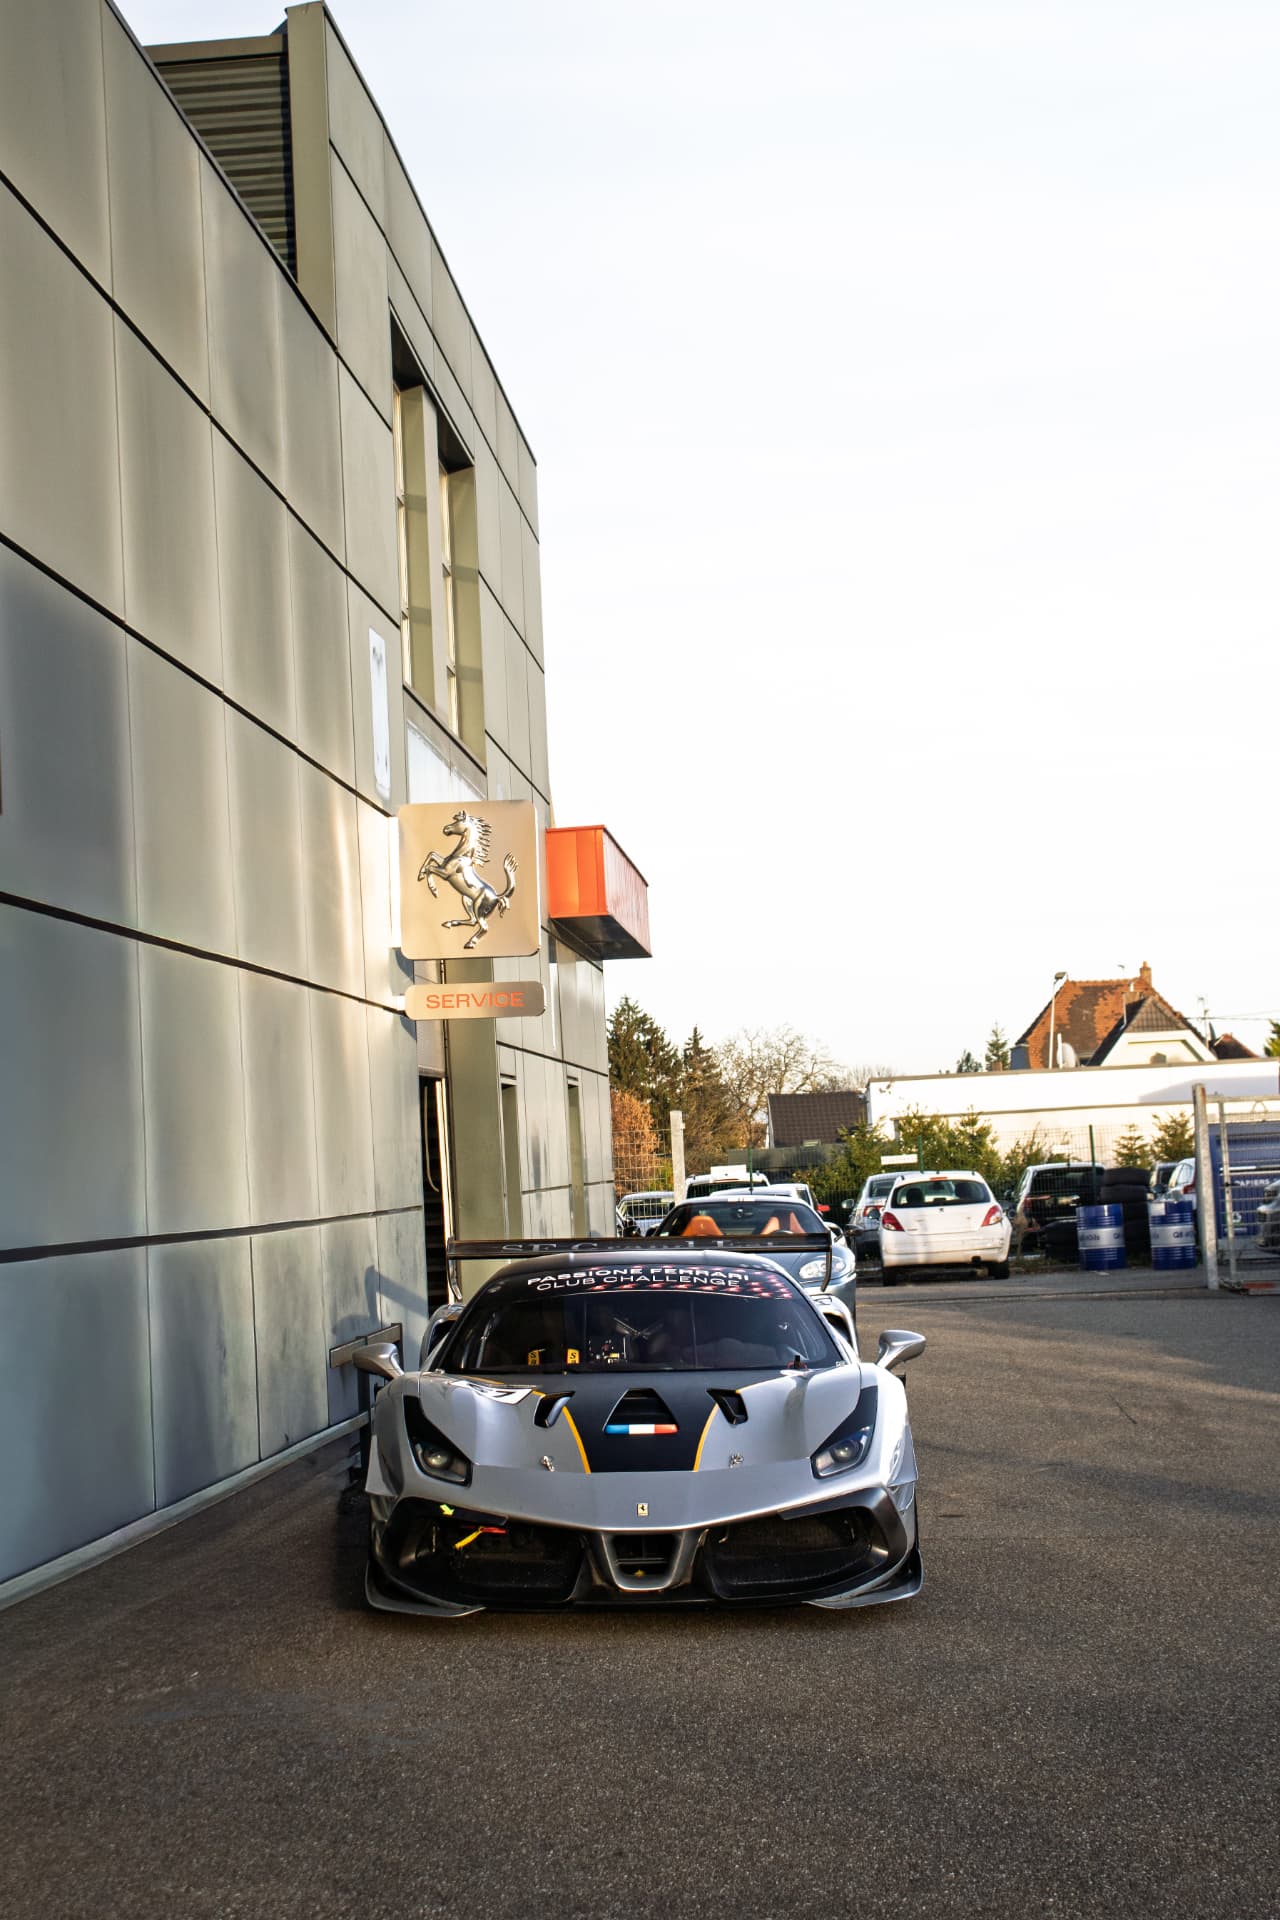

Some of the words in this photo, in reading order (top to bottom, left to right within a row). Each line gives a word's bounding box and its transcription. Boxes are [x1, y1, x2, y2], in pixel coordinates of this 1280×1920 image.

[426, 991, 525, 1009] SERVICE
[527, 1268, 643, 1286] PASSIONE
[650, 1267, 749, 1281] FERRARI
[536, 1277, 596, 1291] CLUB
[603, 1275, 741, 1287] CHALLENGE
